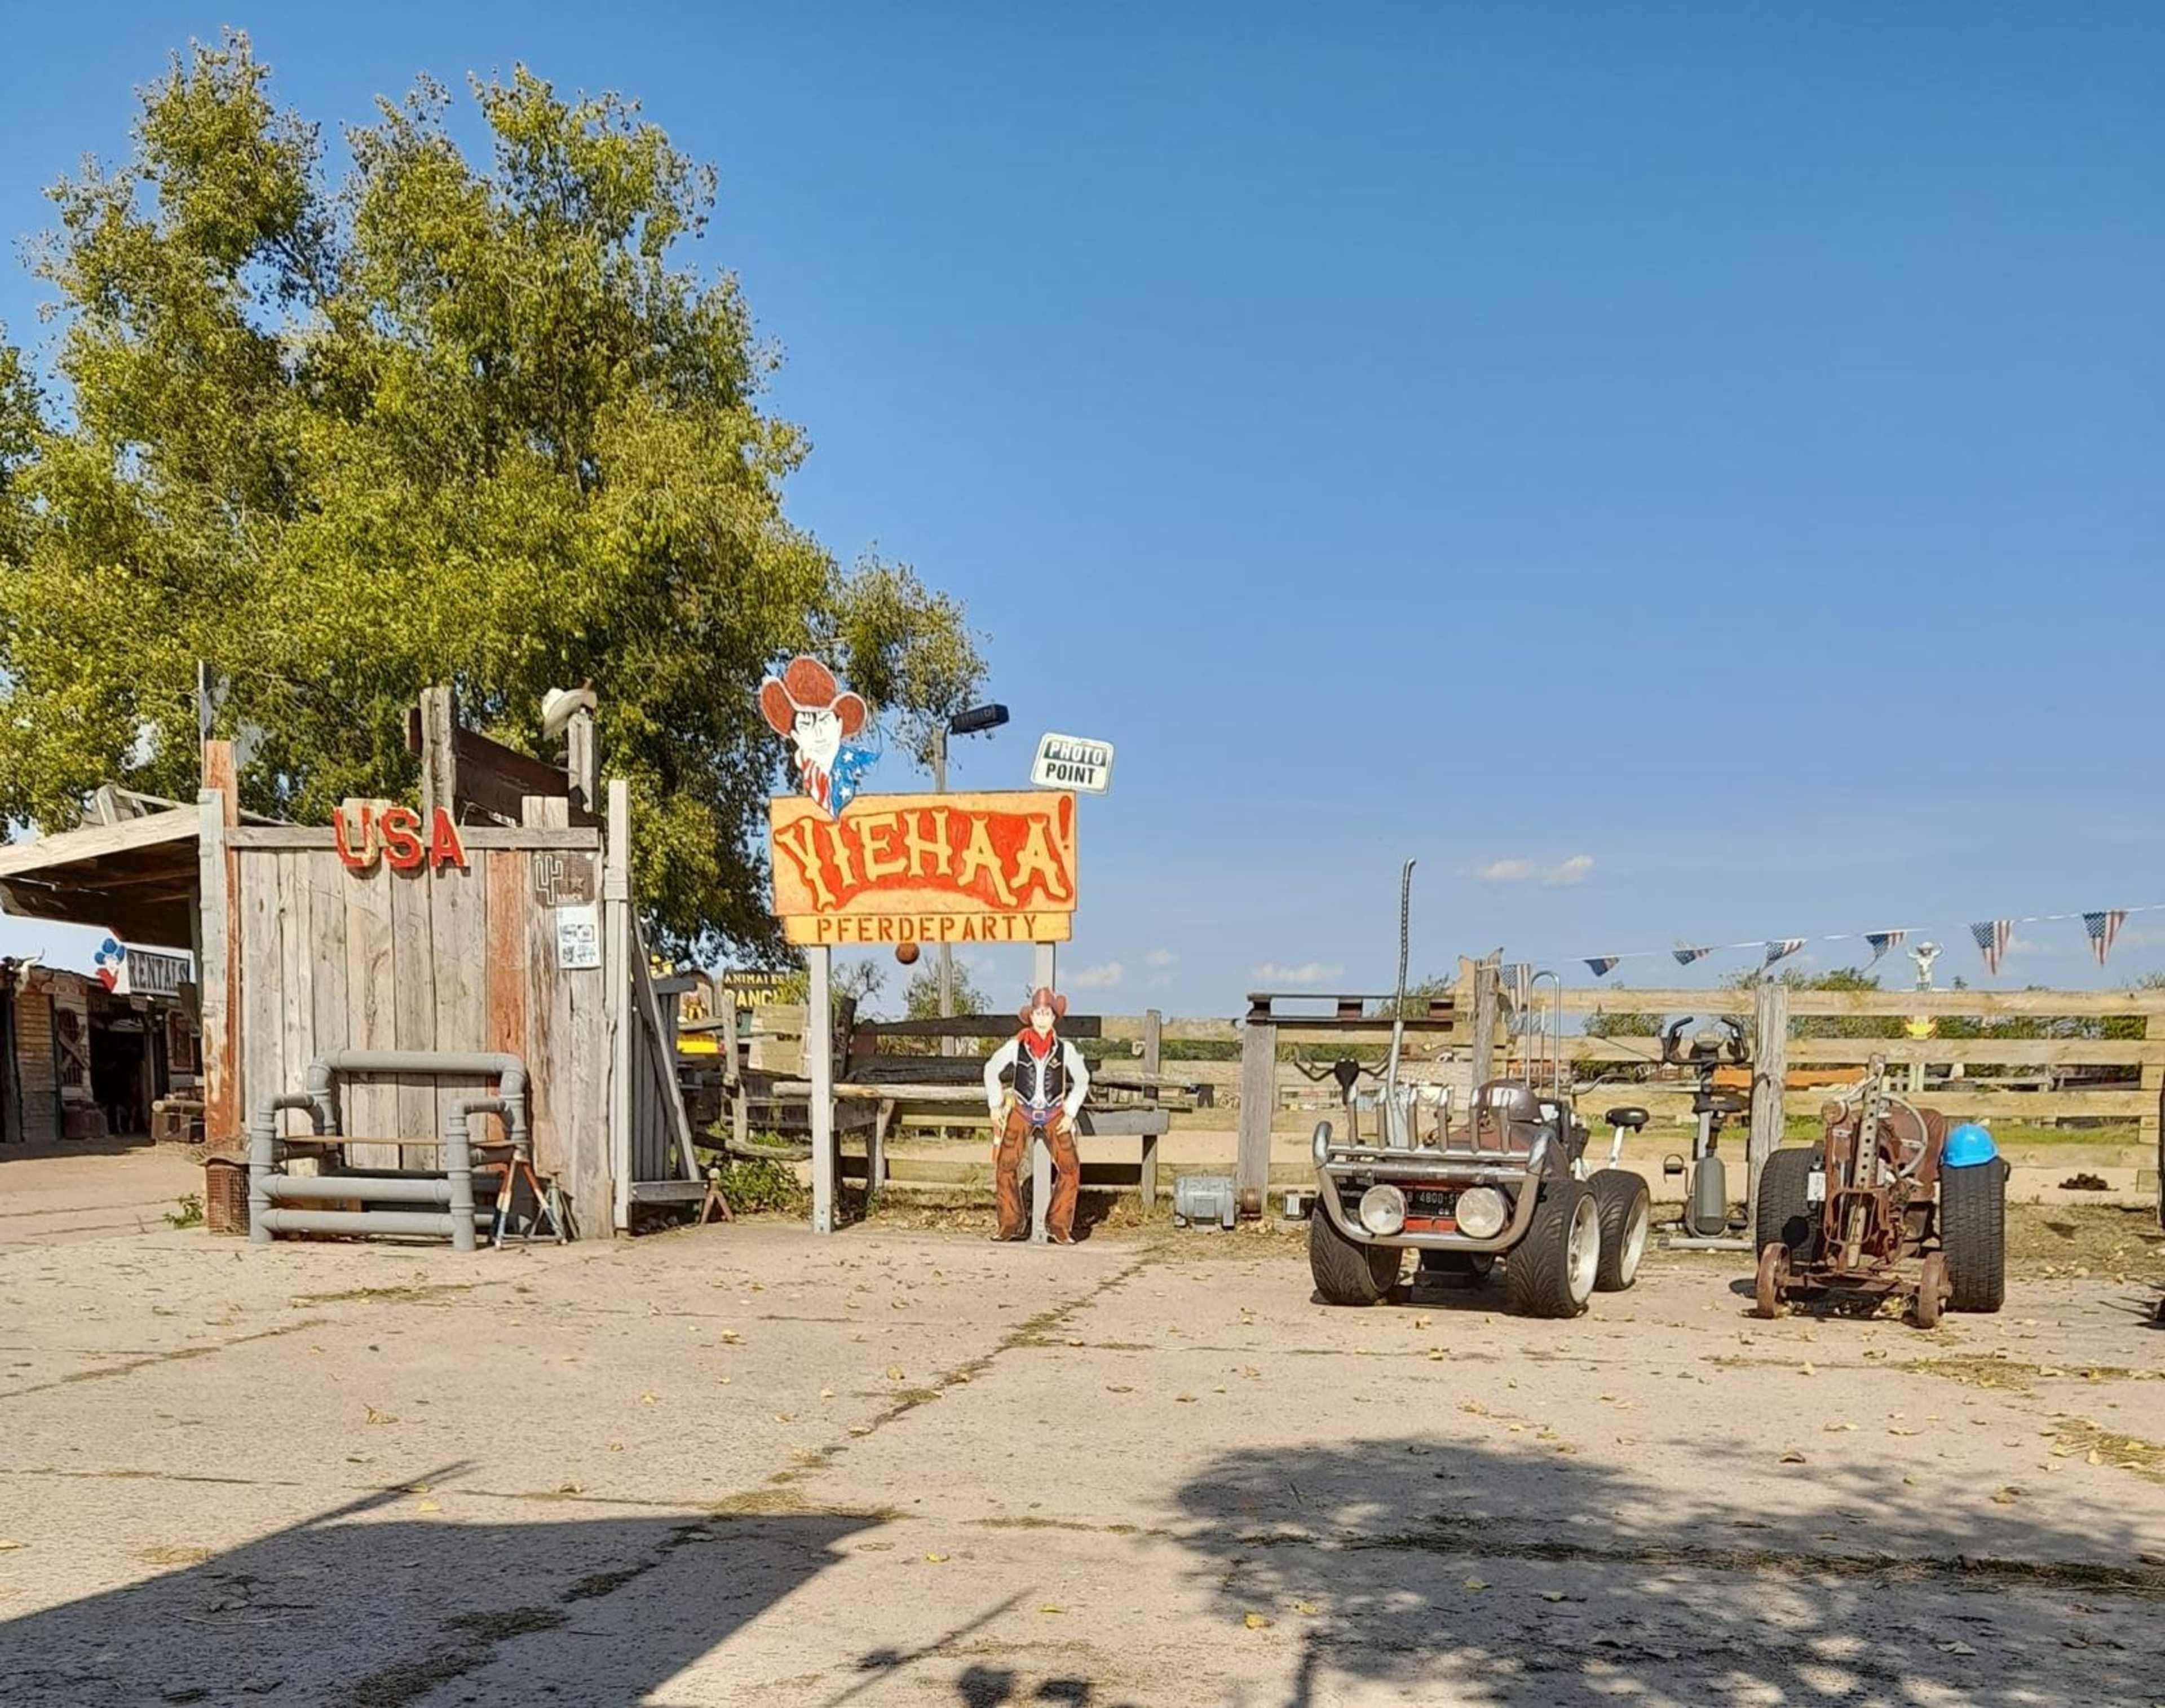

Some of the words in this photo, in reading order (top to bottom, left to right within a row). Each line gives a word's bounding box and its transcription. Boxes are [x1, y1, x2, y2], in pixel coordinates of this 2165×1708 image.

[1049, 740, 1104, 765] PHOTO
[1046, 762, 1095, 784] POINT
[333, 805, 471, 867] USA
[774, 796, 1072, 912] YIEHAA!
[816, 915, 1038, 942] PFERDEPARTY
[127, 952, 188, 991] RENTALS
